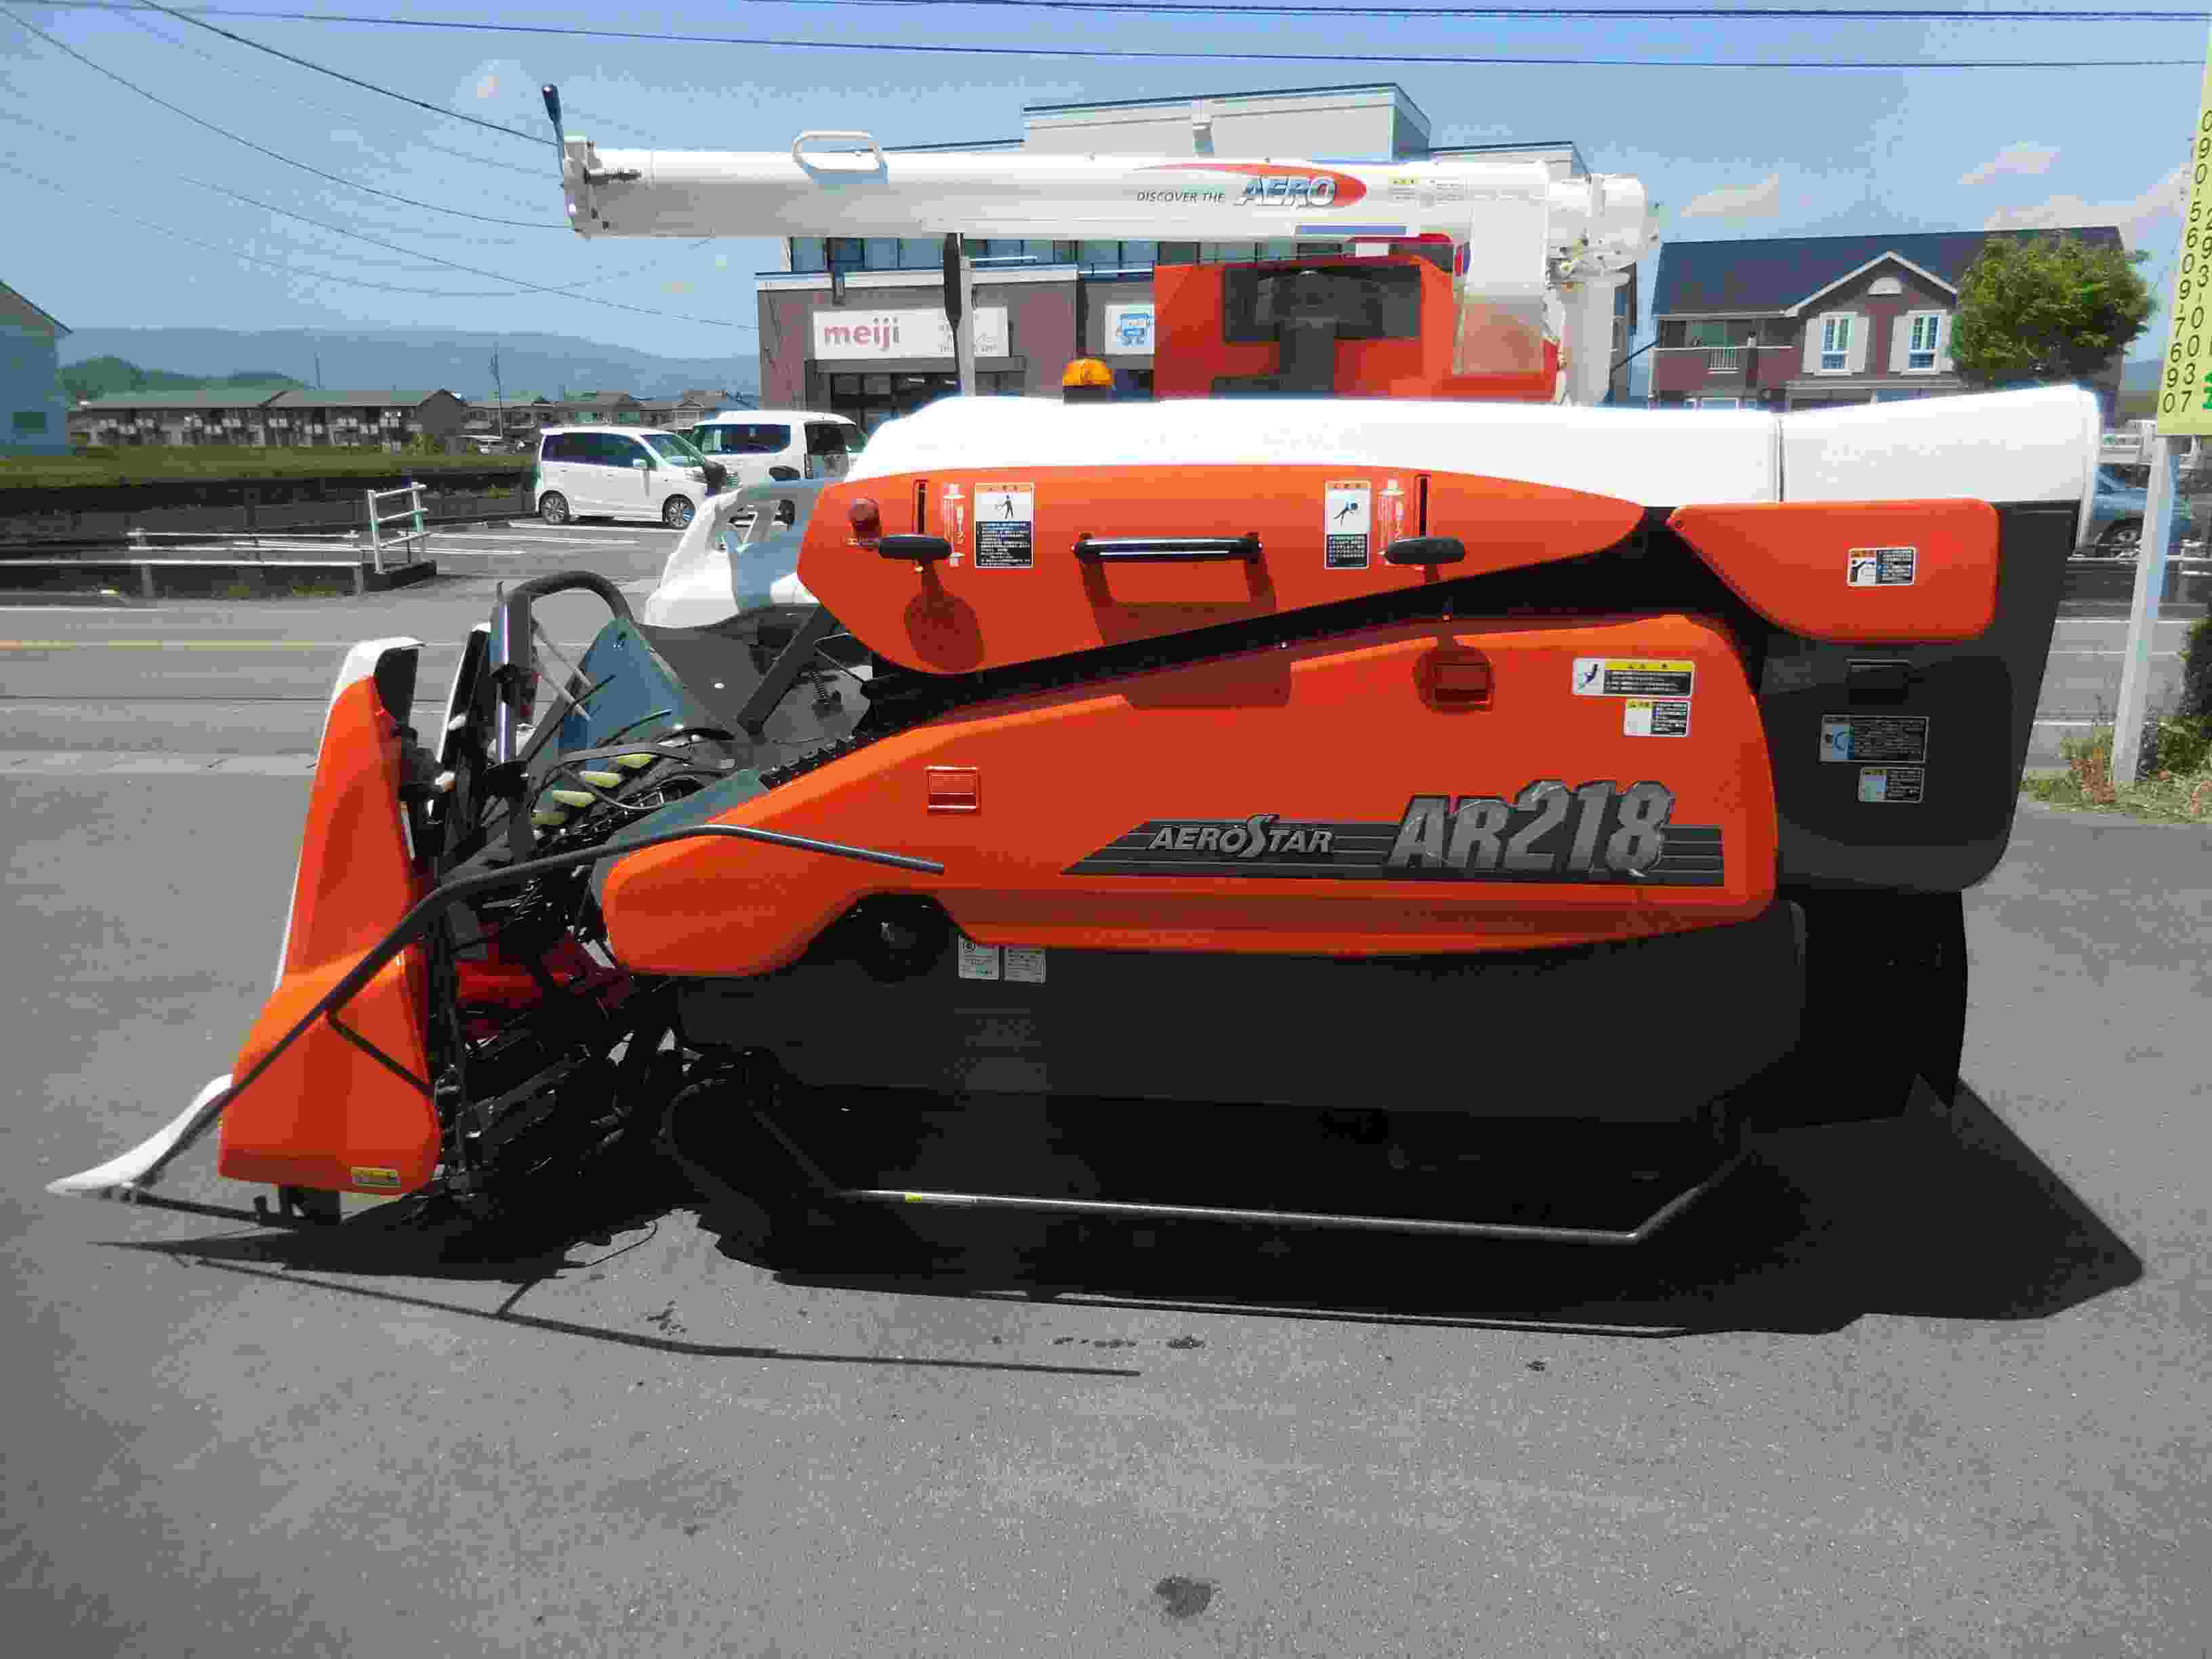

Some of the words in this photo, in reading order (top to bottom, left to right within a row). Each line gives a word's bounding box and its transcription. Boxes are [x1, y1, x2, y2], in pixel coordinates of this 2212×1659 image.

[1136, 189, 1199, 202] DISCOVER
[1203, 189, 1226, 202] THE
[1235, 173, 1337, 206] AERO
[823, 316, 900, 352] meiji
[1387, 780, 1671, 873] AR218
